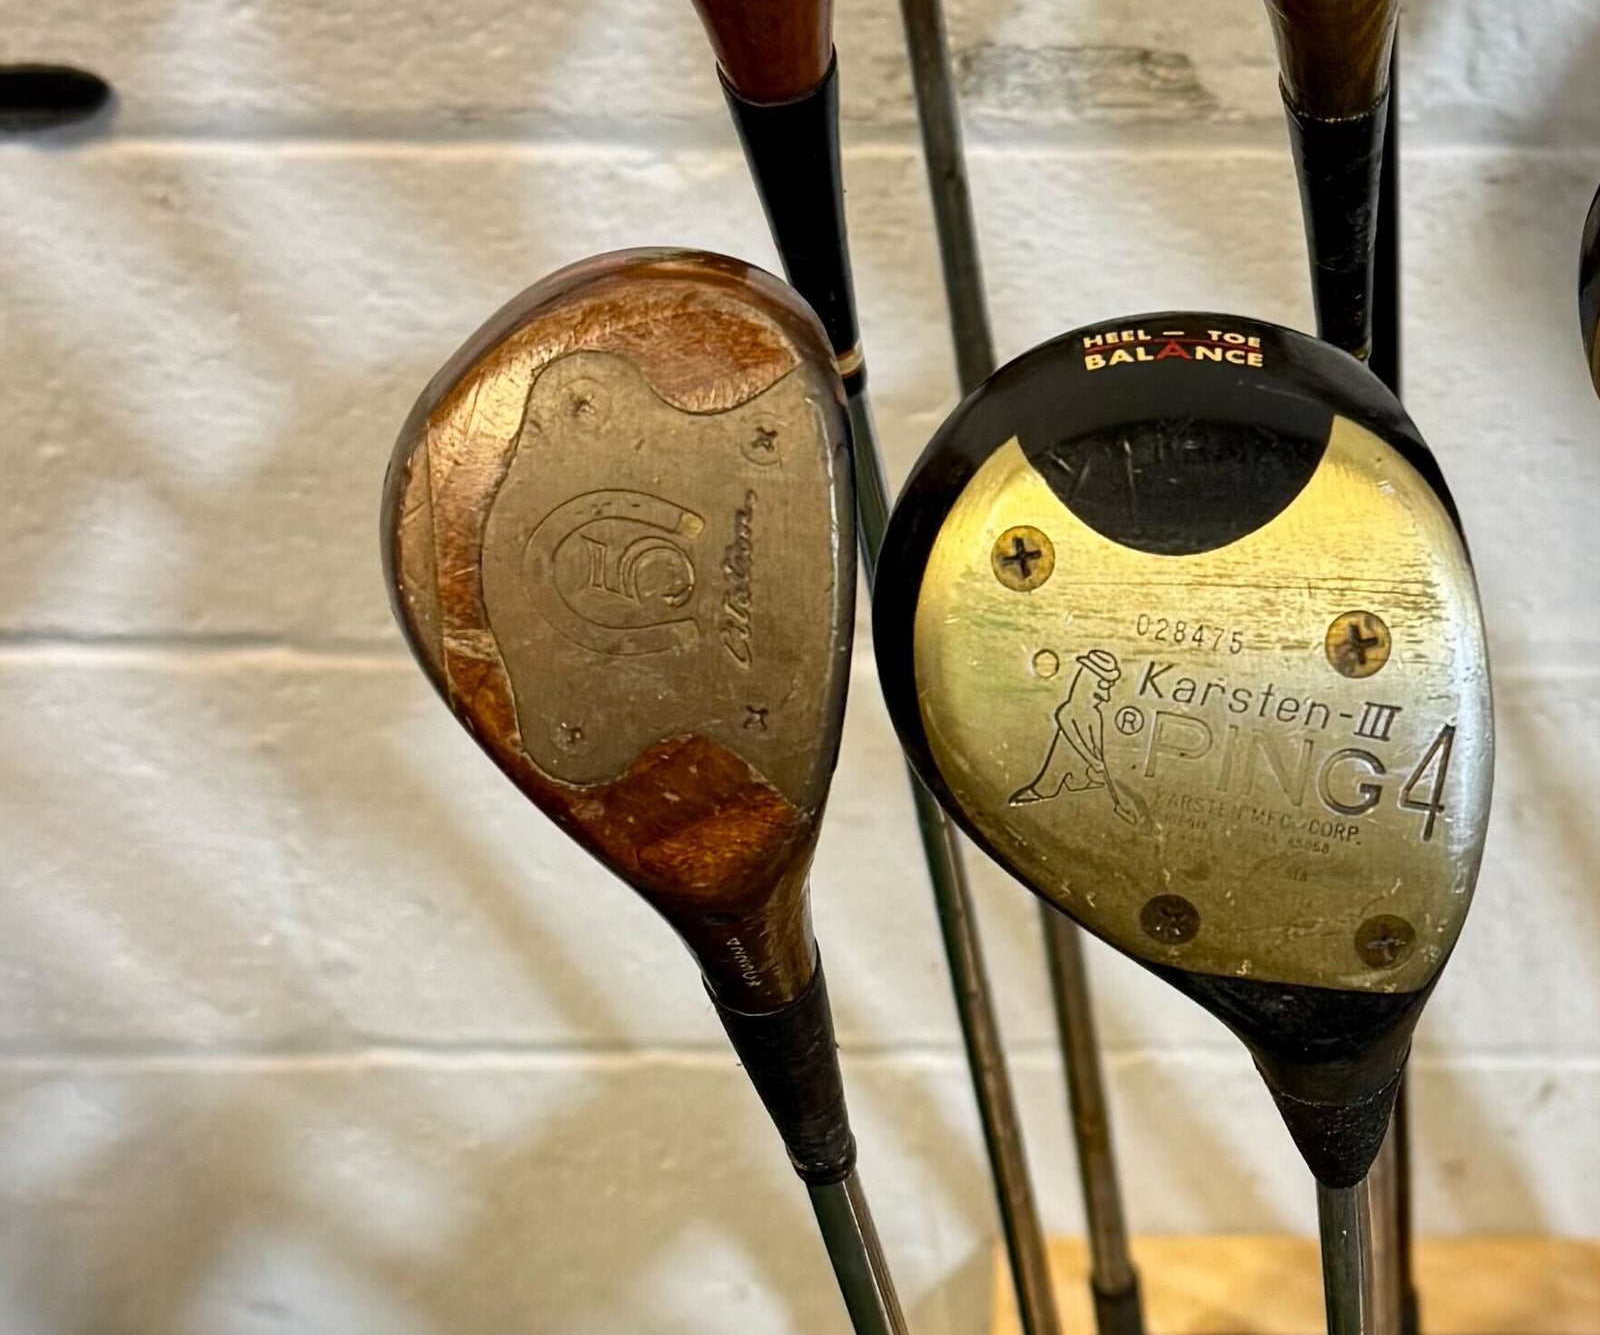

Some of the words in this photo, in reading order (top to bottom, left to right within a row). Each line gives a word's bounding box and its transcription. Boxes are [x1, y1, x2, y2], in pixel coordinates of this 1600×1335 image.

[1083, 329, 1152, 348] HEEL
[1207, 330, 1261, 348] TOE
[1084, 338, 1264, 371] BALANCE
[1136, 613, 1244, 655] 028475
[1142, 709, 1387, 817] PING
[1398, 722, 1457, 842] 4
[1308, 818, 1363, 846] CORP.
